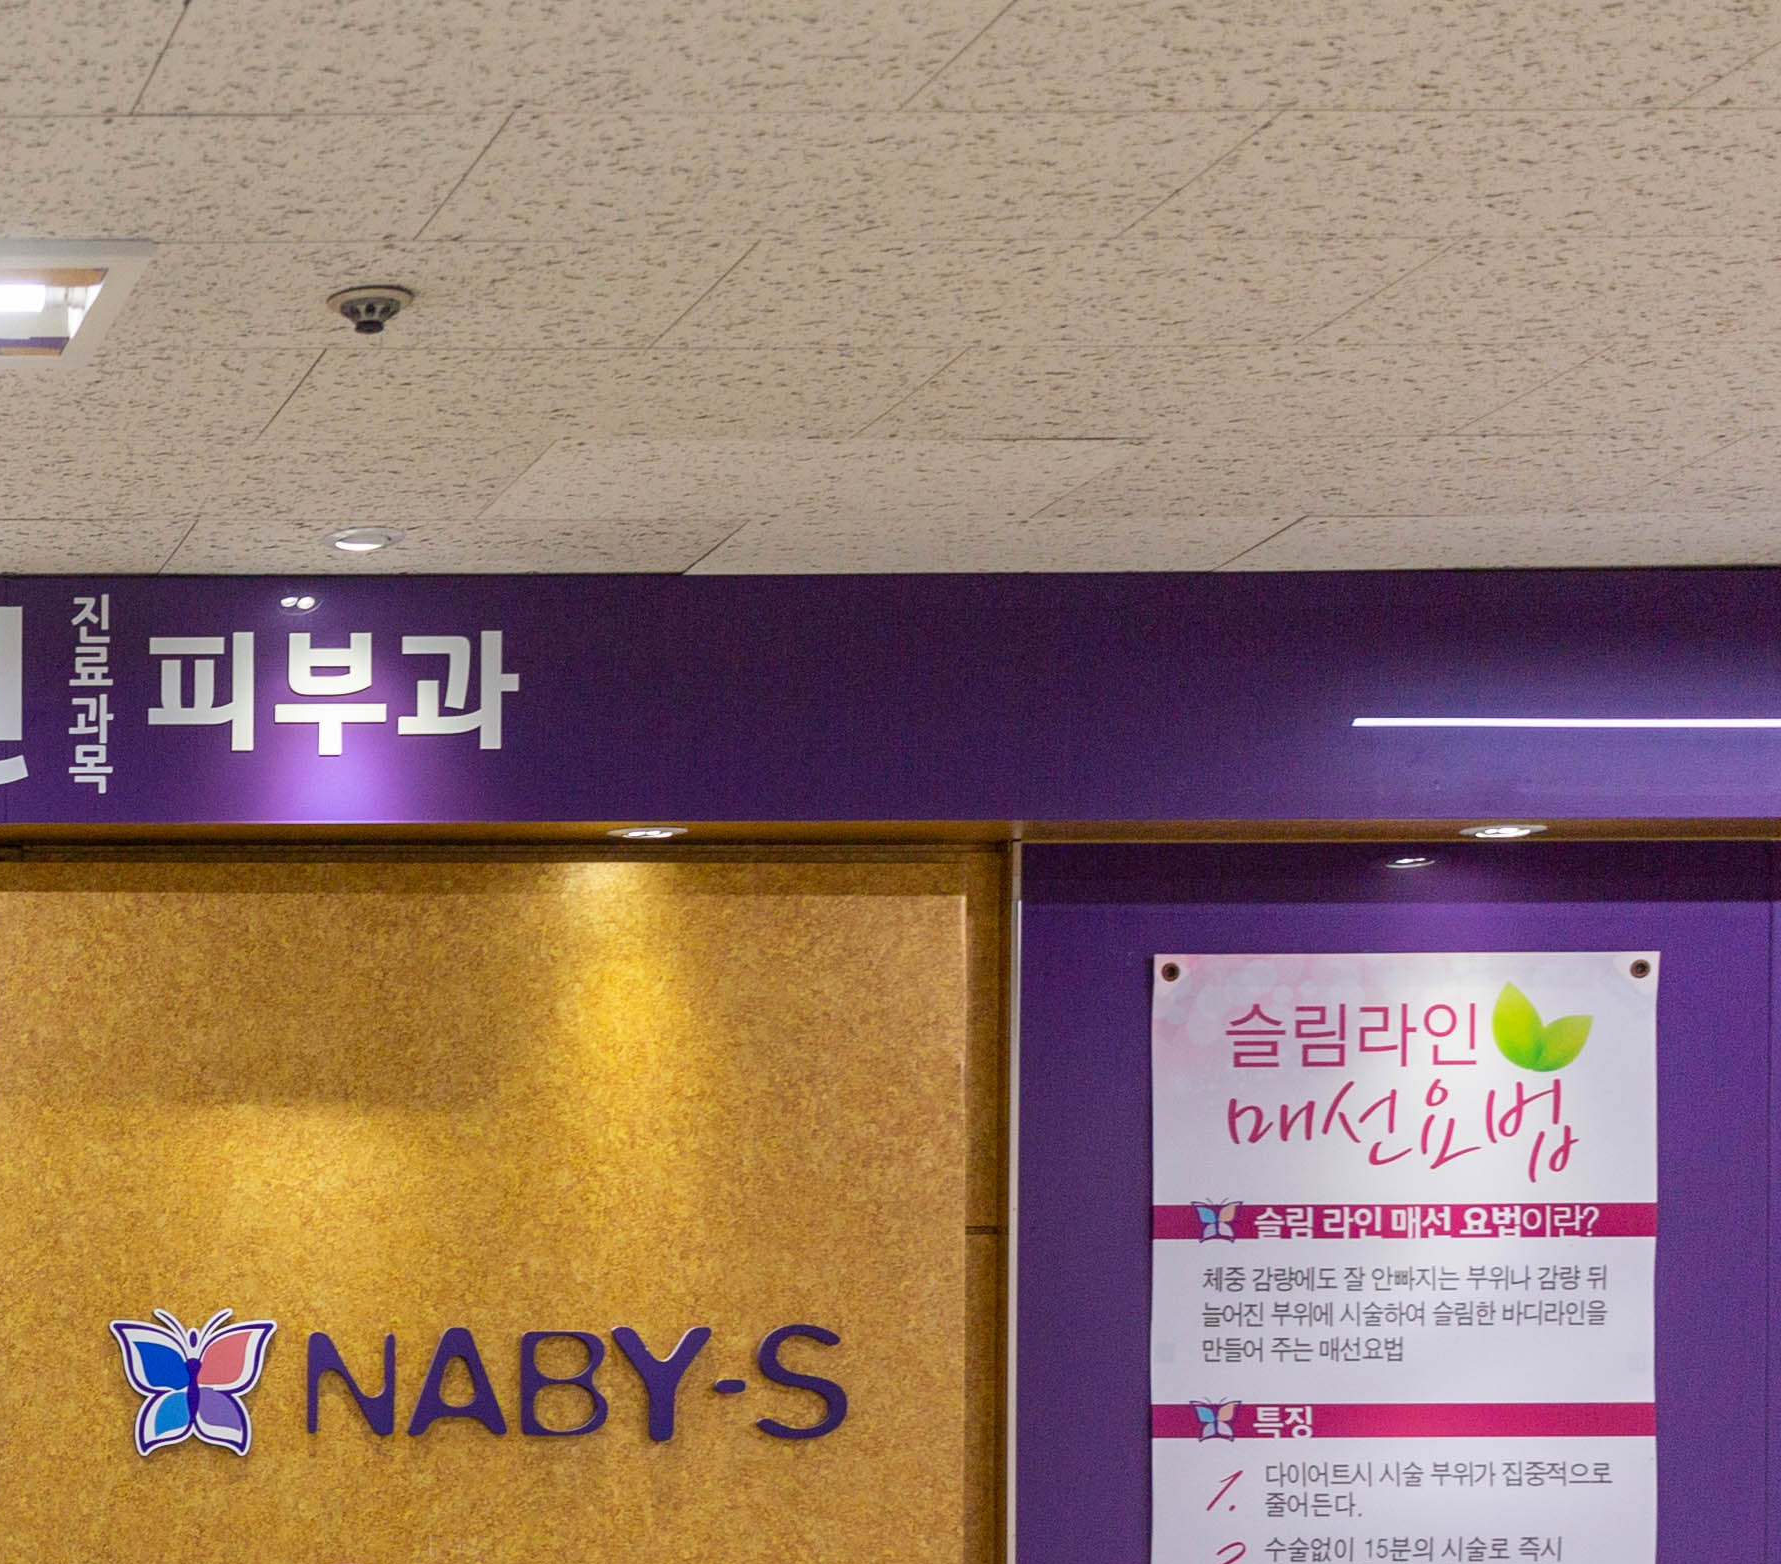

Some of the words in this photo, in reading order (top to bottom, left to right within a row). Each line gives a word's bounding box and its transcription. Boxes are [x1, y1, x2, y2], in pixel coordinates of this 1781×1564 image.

[68, 593, 114, 794] 진료과목
[147, 630, 520, 756] 피부과
[1225, 1002, 1477, 1068] 슬림라인
[1227, 1078, 1579, 1183] 매선요법
[1254, 1209, 1314, 1238] 슬림
[1323, 1209, 1382, 1238] 라인
[1390, 1209, 1452, 1238] 매선
[1460, 1206, 1600, 1237] 요법이란?
[1202, 1267, 1246, 1292] 체중
[1252, 1267, 1337, 1292] 감량에도
[1344, 1267, 1366, 1292] 잘
[1372, 1266, 1460, 1292] 안빠지는
[1466, 1265, 1531, 1291] 부위나
[1537, 1266, 1580, 1291] 감량
[1586, 1265, 1607, 1291] 뒤
[1202, 1303, 1264, 1328] 늘어진
[1270, 1302, 1334, 1327] 부위에
[1340, 1302, 1425, 1327] 시술하여
[1432, 1301, 1496, 1326] 슬림한
[1502, 1301, 1607, 1326] 바디라인을
[1202, 1339, 1264, 1363] 만들어
[1270, 1338, 1313, 1363] 주는
[1319, 1337, 1404, 1362] 매선요법
[307, 1323, 848, 1443] NABY-S
[1252, 1406, 1313, 1439] 특징
[1207, 1470, 1243, 1512] 1.
[1265, 1462, 1372, 1487] 다이어트시
[1380, 1461, 1425, 1486] 시술
[1431, 1461, 1496, 1486] 부위가
[1502, 1461, 1613, 1486] 집중적으로
[1264, 1493, 1363, 1518] 줄어든다.
[1264, 1537, 1354, 1561] 수술없이
[1365, 1537, 1434, 1561] 15분의
[1441, 1537, 1510, 1561] 시술로
[1518, 1536, 1562, 1561] 즉시
